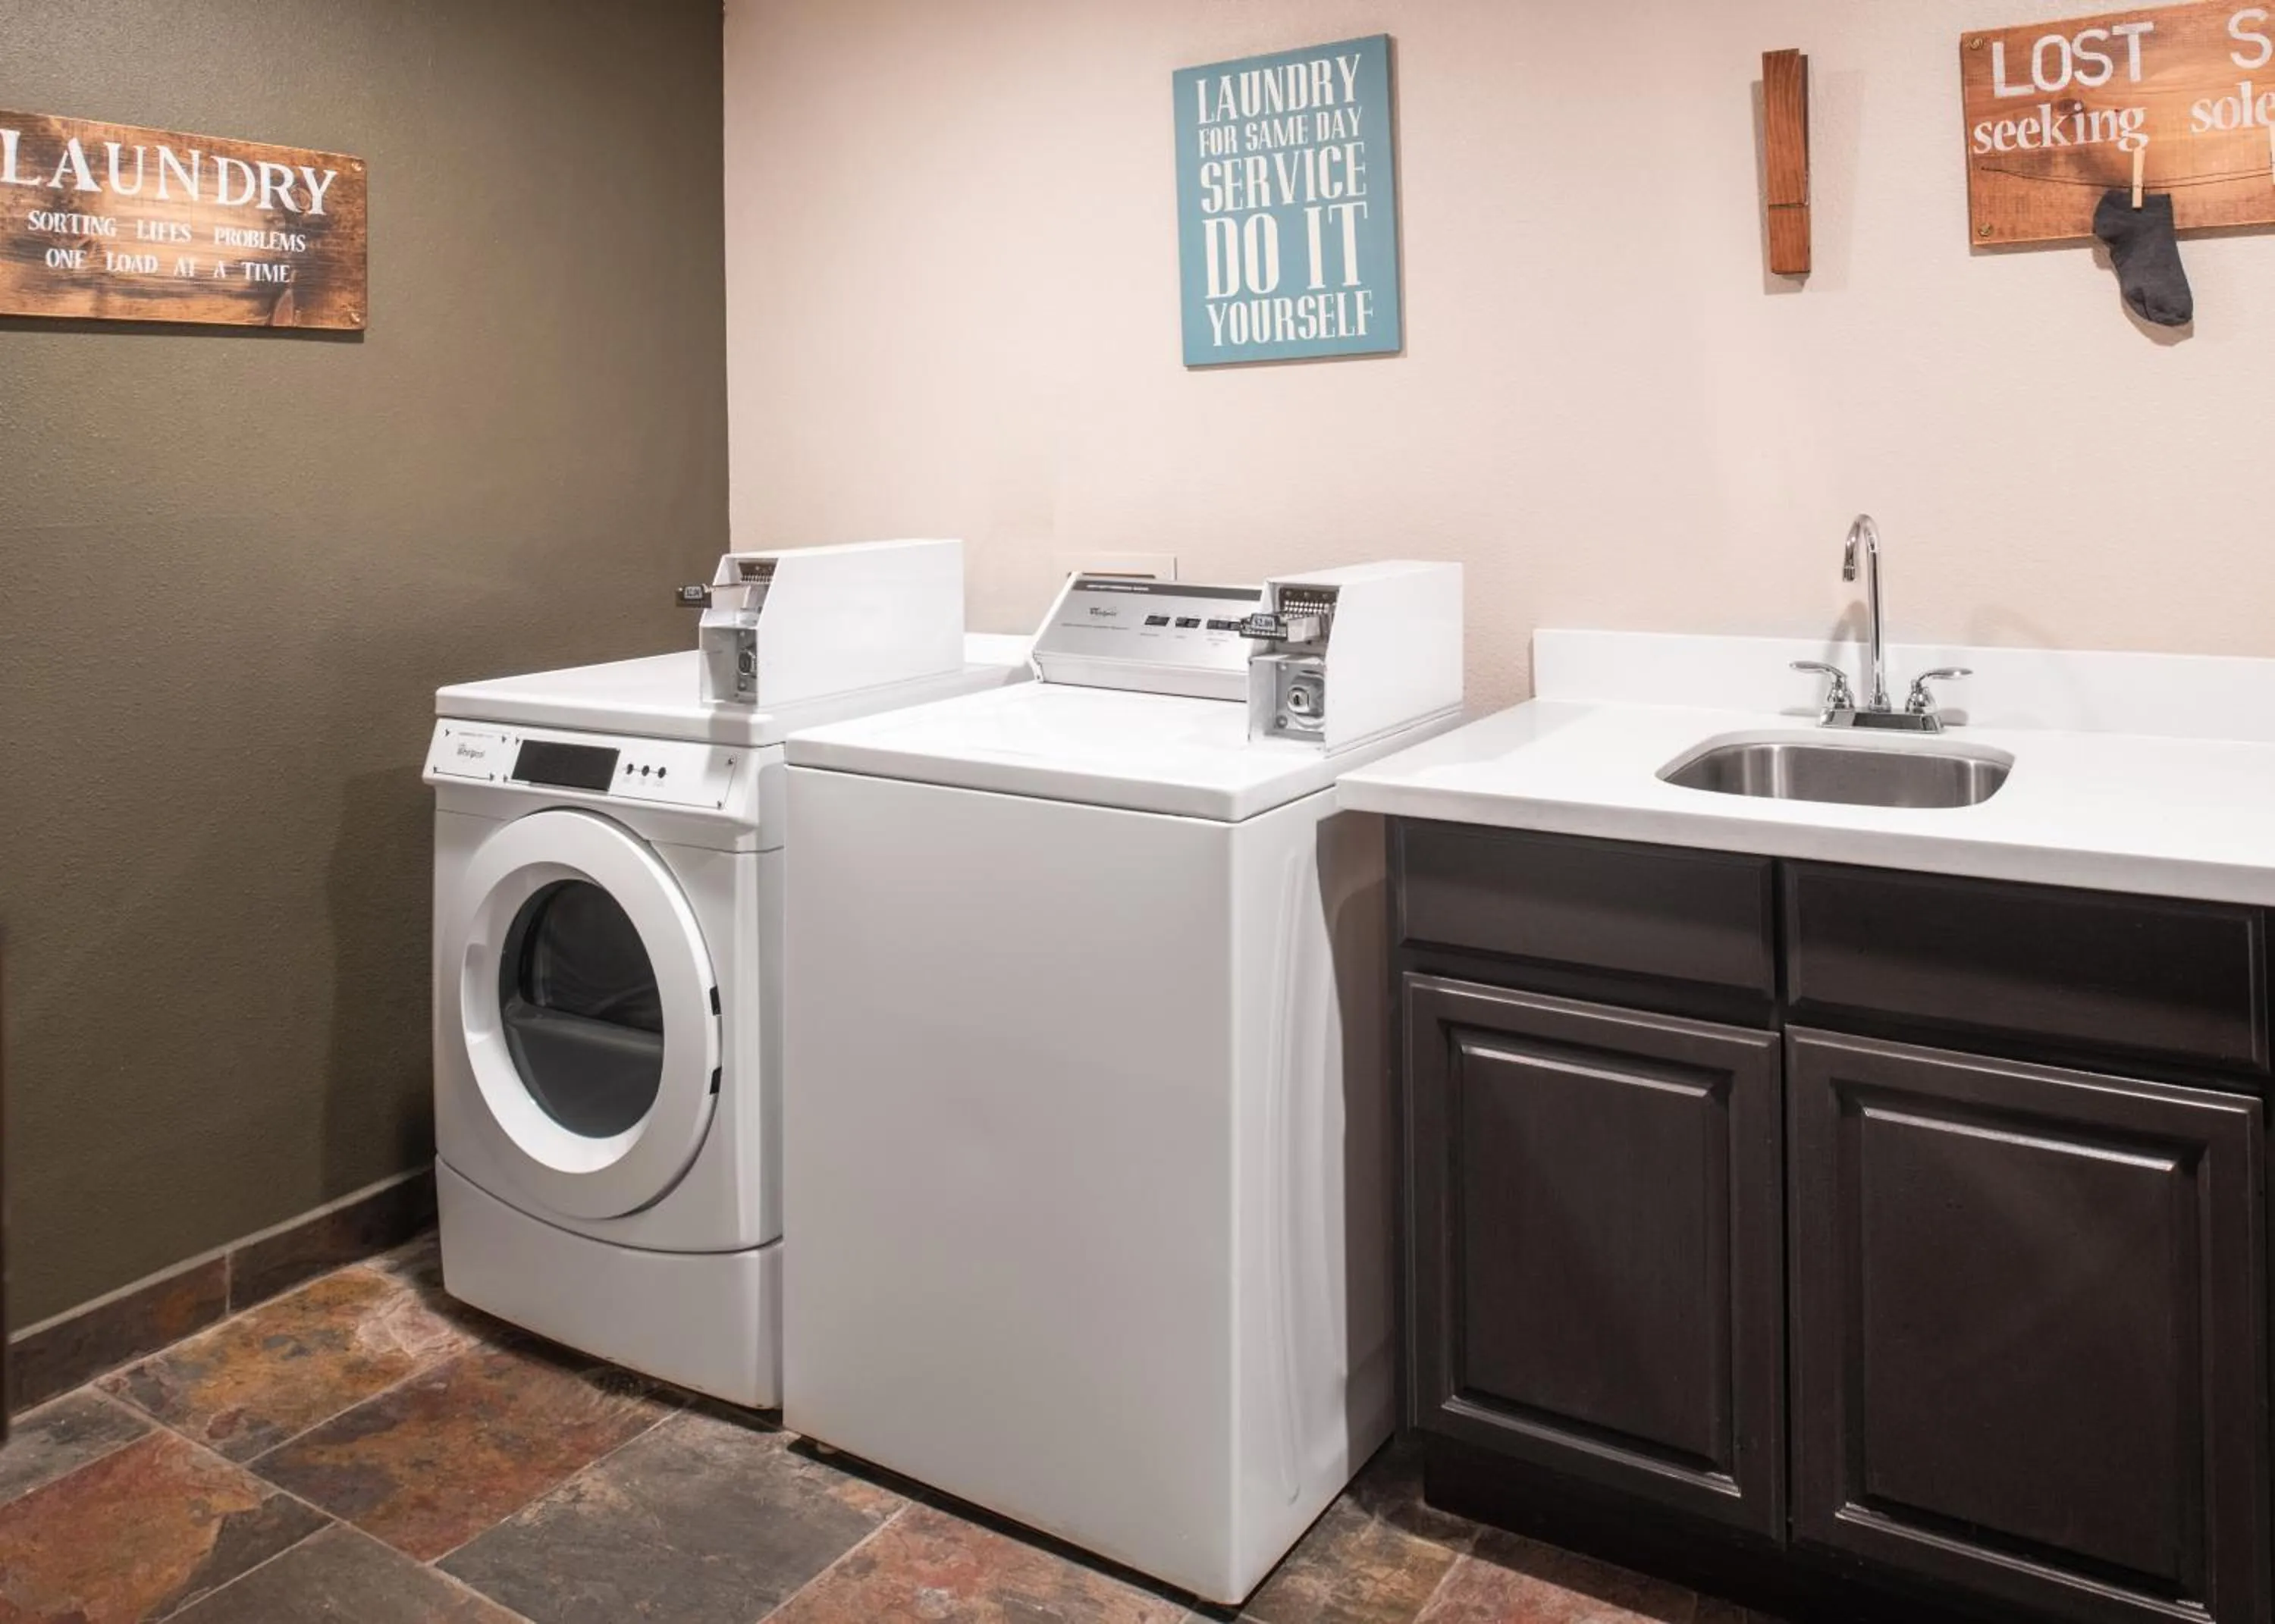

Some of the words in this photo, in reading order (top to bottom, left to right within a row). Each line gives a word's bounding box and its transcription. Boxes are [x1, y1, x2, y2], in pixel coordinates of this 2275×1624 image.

[1196, 53, 1362, 124] LAUNDRY
[1991, 21, 2155, 99] LOST
[1198, 124, 1238, 158] FOR
[1244, 114, 1309, 152] SAME
[1316, 106, 1363, 143] DAY
[1973, 102, 2149, 155] seeking
[0, 127, 337, 216] LAUNDRY
[1200, 141, 1367, 215] SERVICE
[27, 210, 118, 237] SORTING
[213, 226, 306, 252] PROBLEMS
[1203, 212, 1280, 299] DO
[1304, 201, 1369, 290] IT
[46, 248, 87, 269] ONE
[105, 251, 158, 274] LOAD
[174, 256, 197, 277] AT
[213, 260, 226, 278] A
[241, 262, 291, 284] TIME
[1206, 290, 1374, 347] YOURSELF
